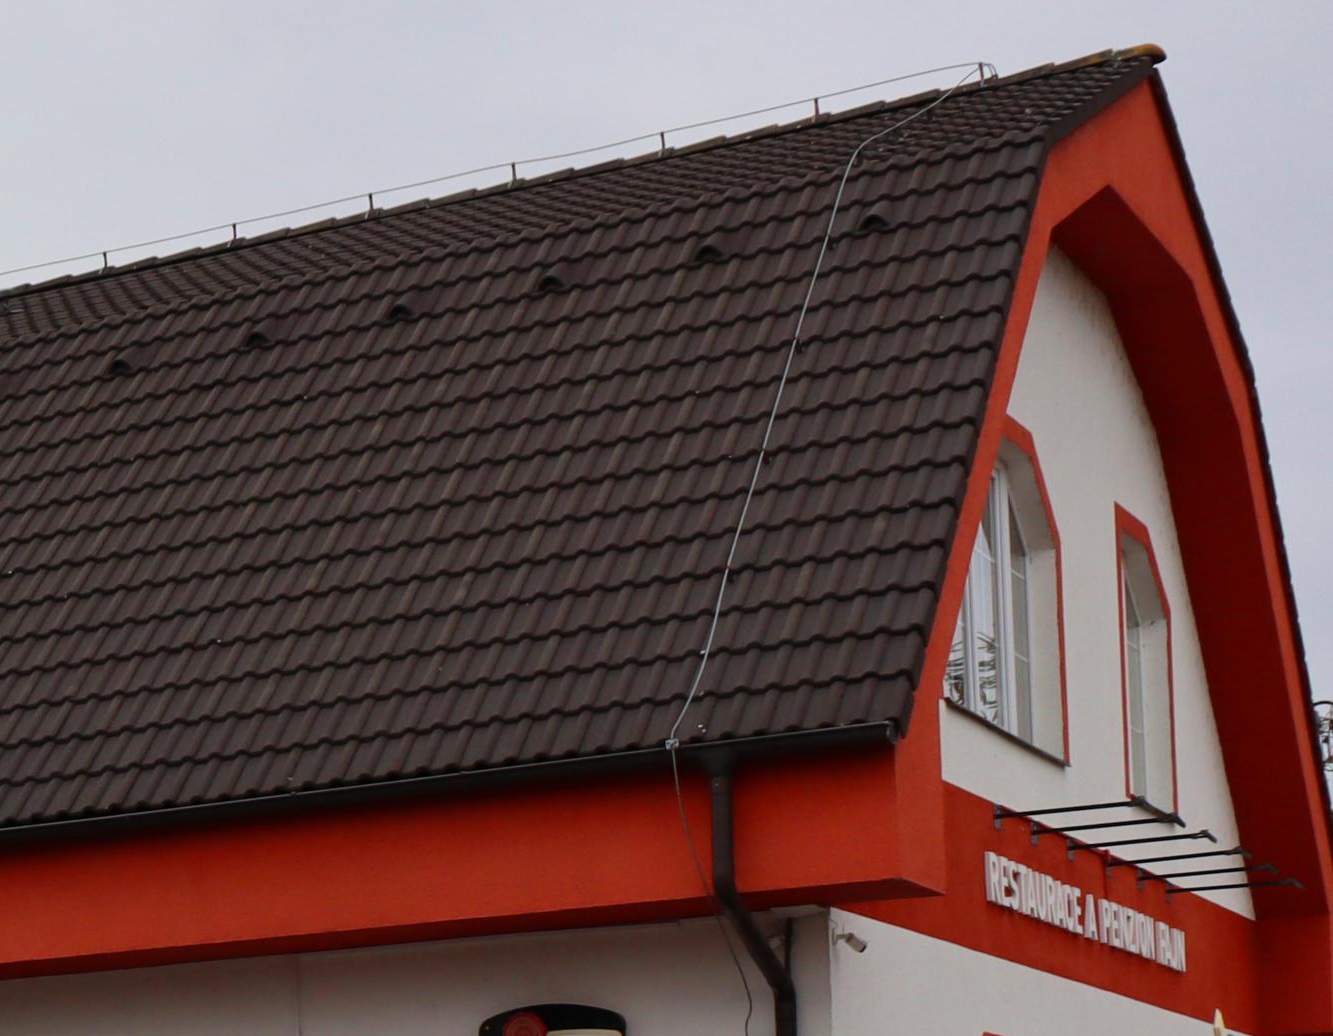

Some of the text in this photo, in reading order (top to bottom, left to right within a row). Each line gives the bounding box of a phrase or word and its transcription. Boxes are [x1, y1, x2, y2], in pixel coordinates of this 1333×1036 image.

[984, 851, 1083, 935] RESTAURACE
[1084, 893, 1098, 941] A
[1099, 898, 1156, 961] PENZION
